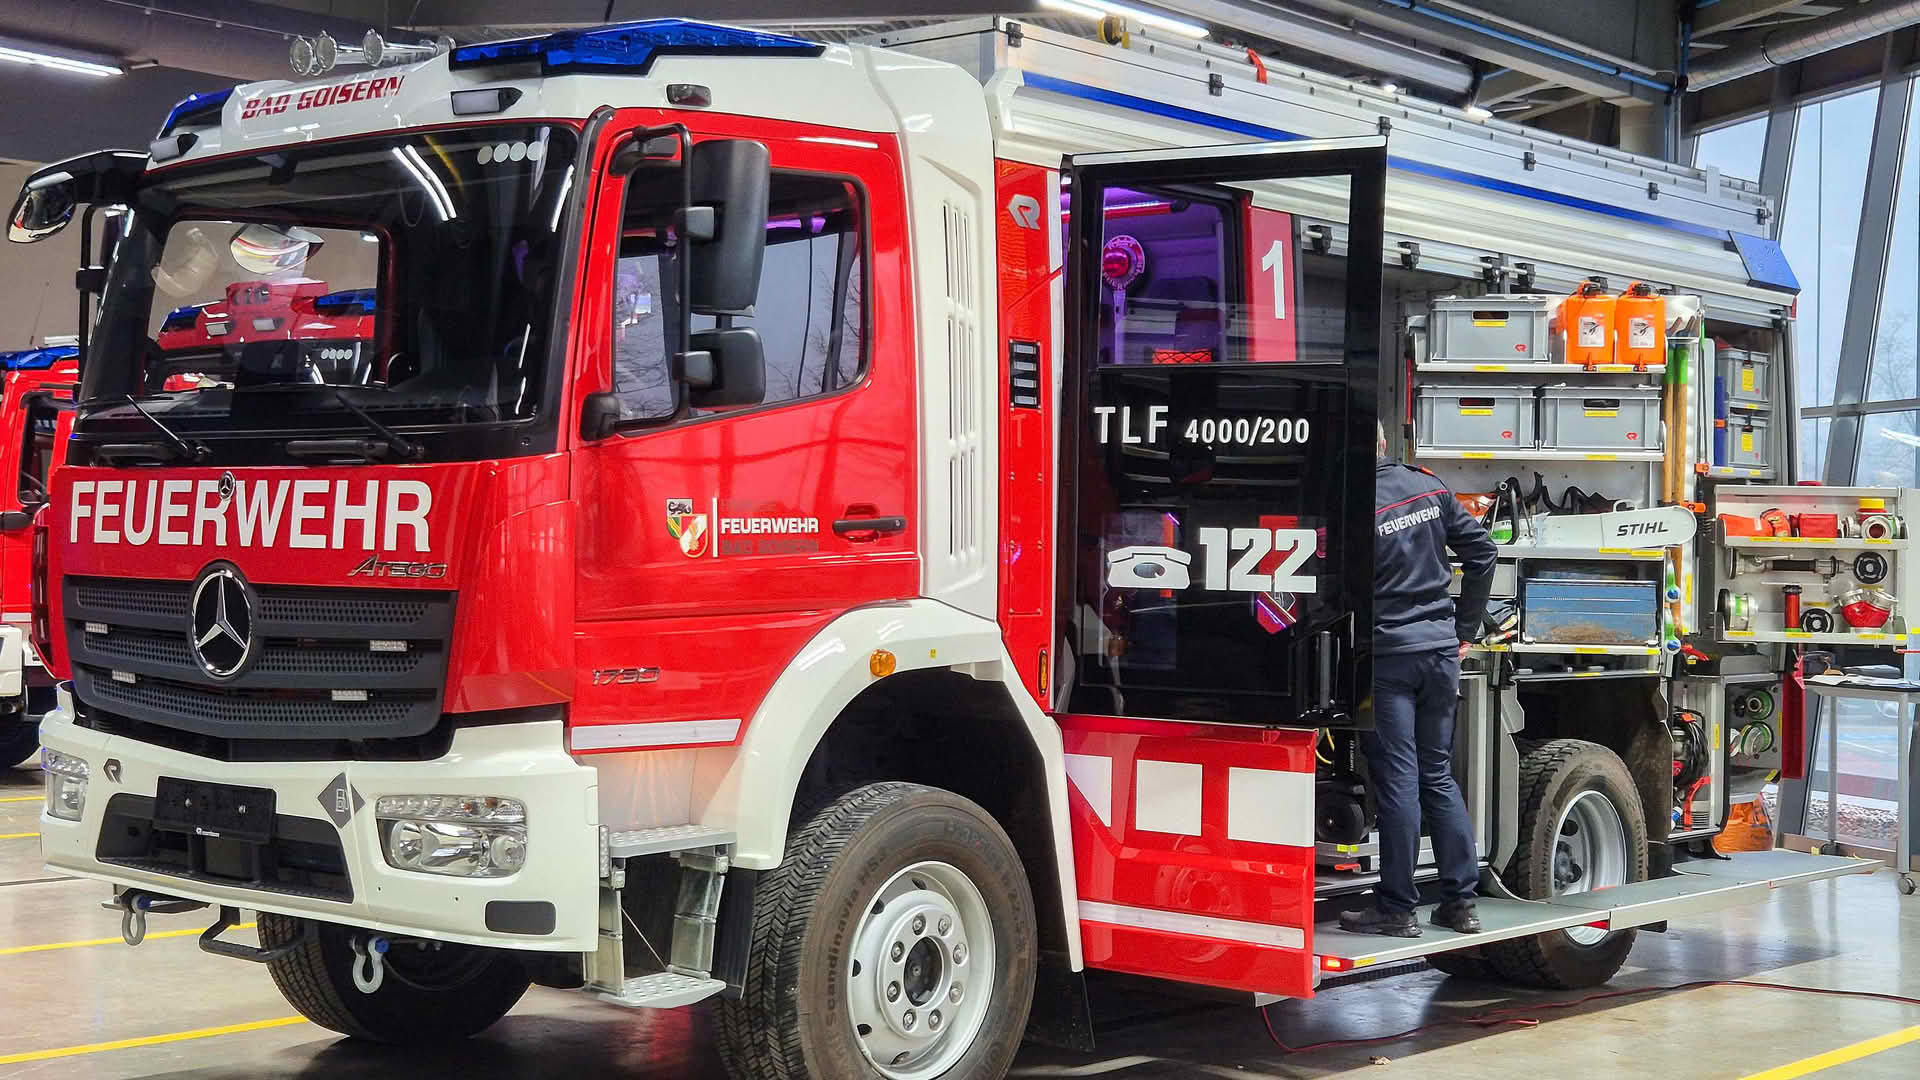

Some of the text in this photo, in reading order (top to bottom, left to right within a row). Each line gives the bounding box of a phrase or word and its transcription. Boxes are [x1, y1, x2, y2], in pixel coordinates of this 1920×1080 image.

[242, 75, 404, 119] BAD GOISERN
[1262, 240, 1285, 319] 1
[1094, 405, 1310, 446] TLF 4000/200
[70, 480, 432, 552] FEUERWEHR
[720, 517, 819, 534] FEUERWEHR
[1377, 505, 1441, 537] FEUERWEHR
[1617, 521, 1669, 537] STIHL
[1199, 528, 1317, 593] 122
